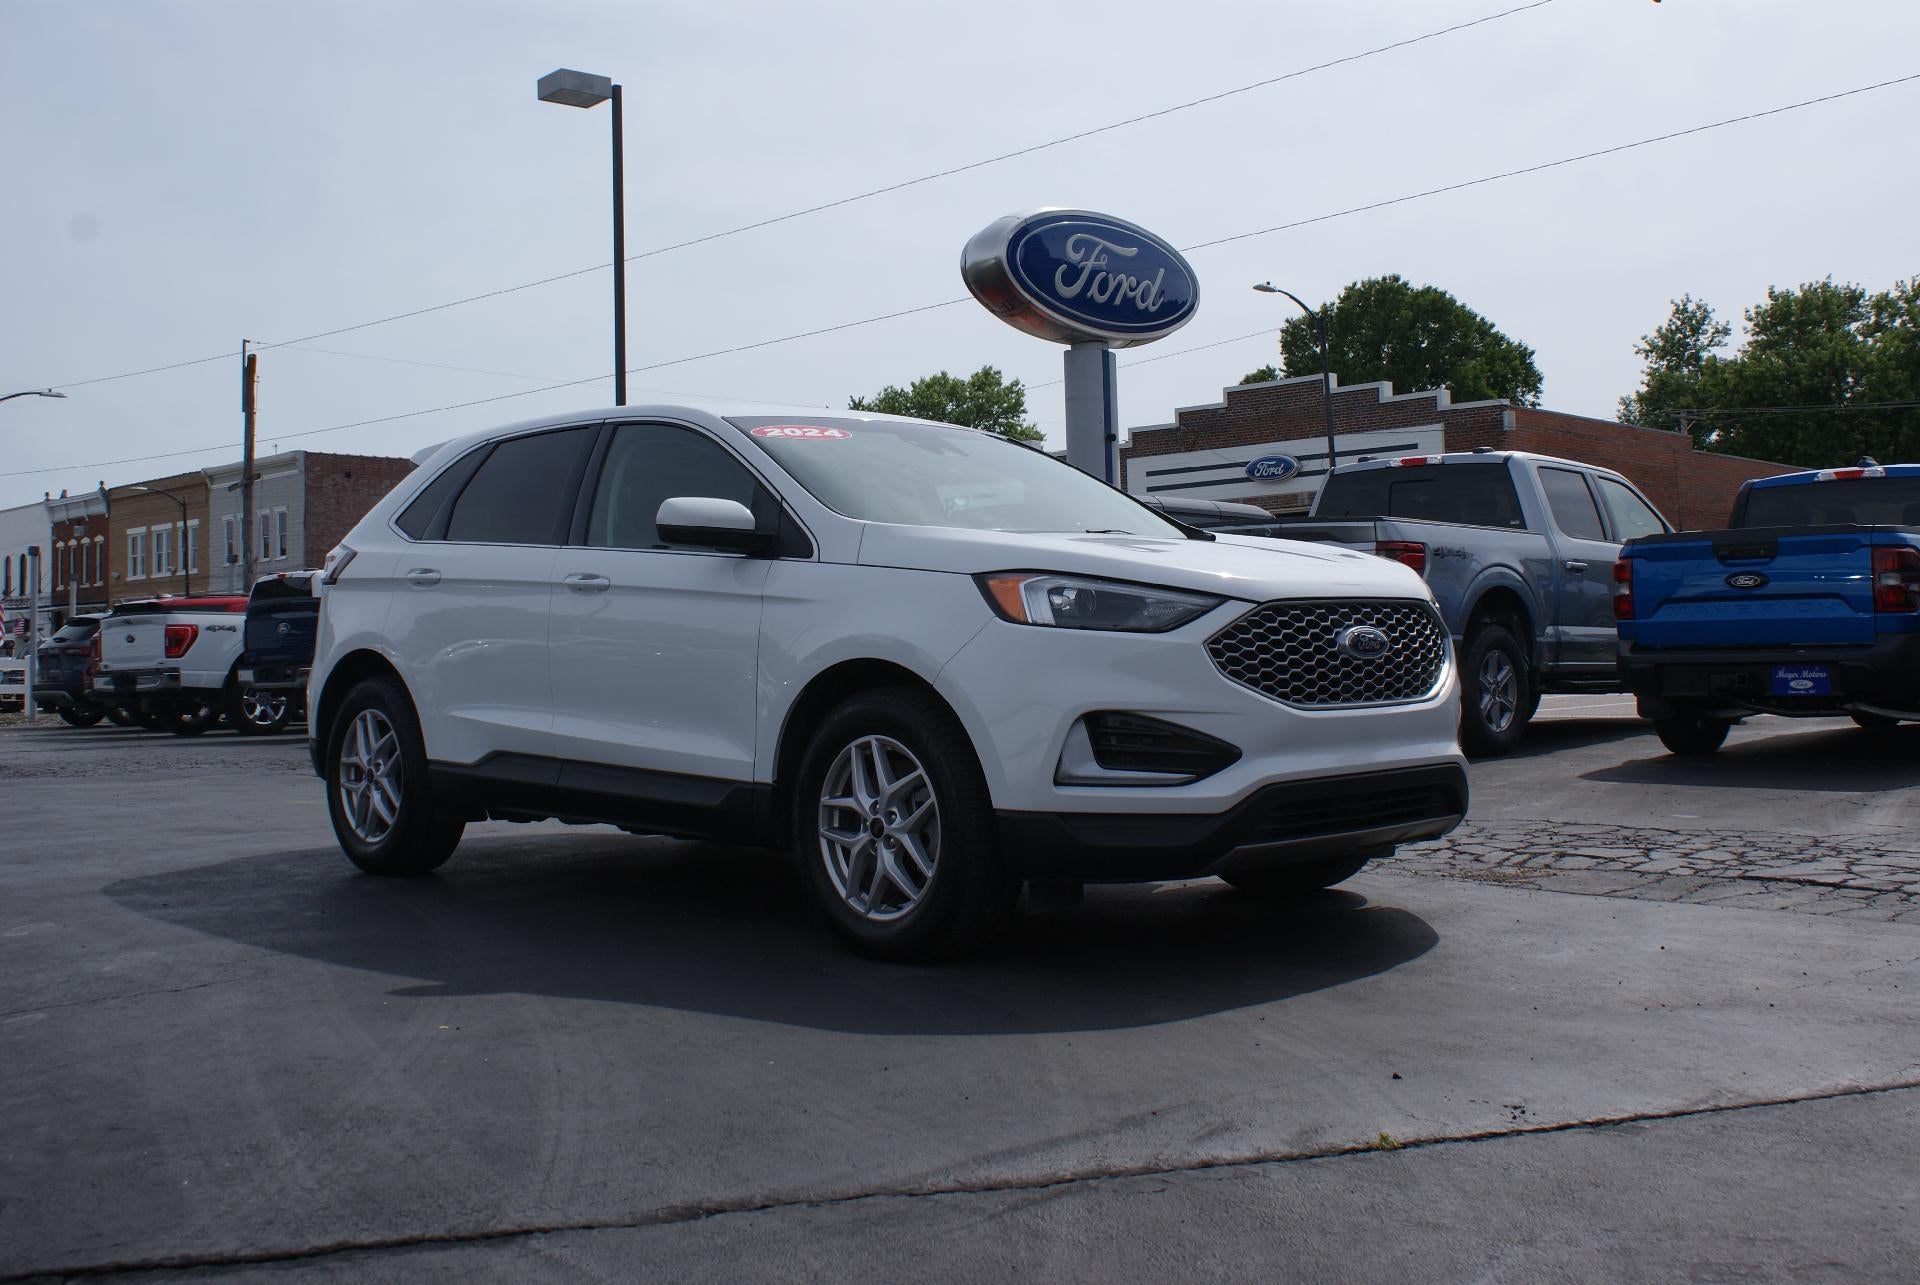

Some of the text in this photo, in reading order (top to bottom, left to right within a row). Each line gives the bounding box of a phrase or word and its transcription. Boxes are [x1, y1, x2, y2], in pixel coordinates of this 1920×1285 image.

[1055, 234, 1164, 312] Ford
[764, 428, 843, 437] 2024
[1254, 461, 1284, 477] Ford
